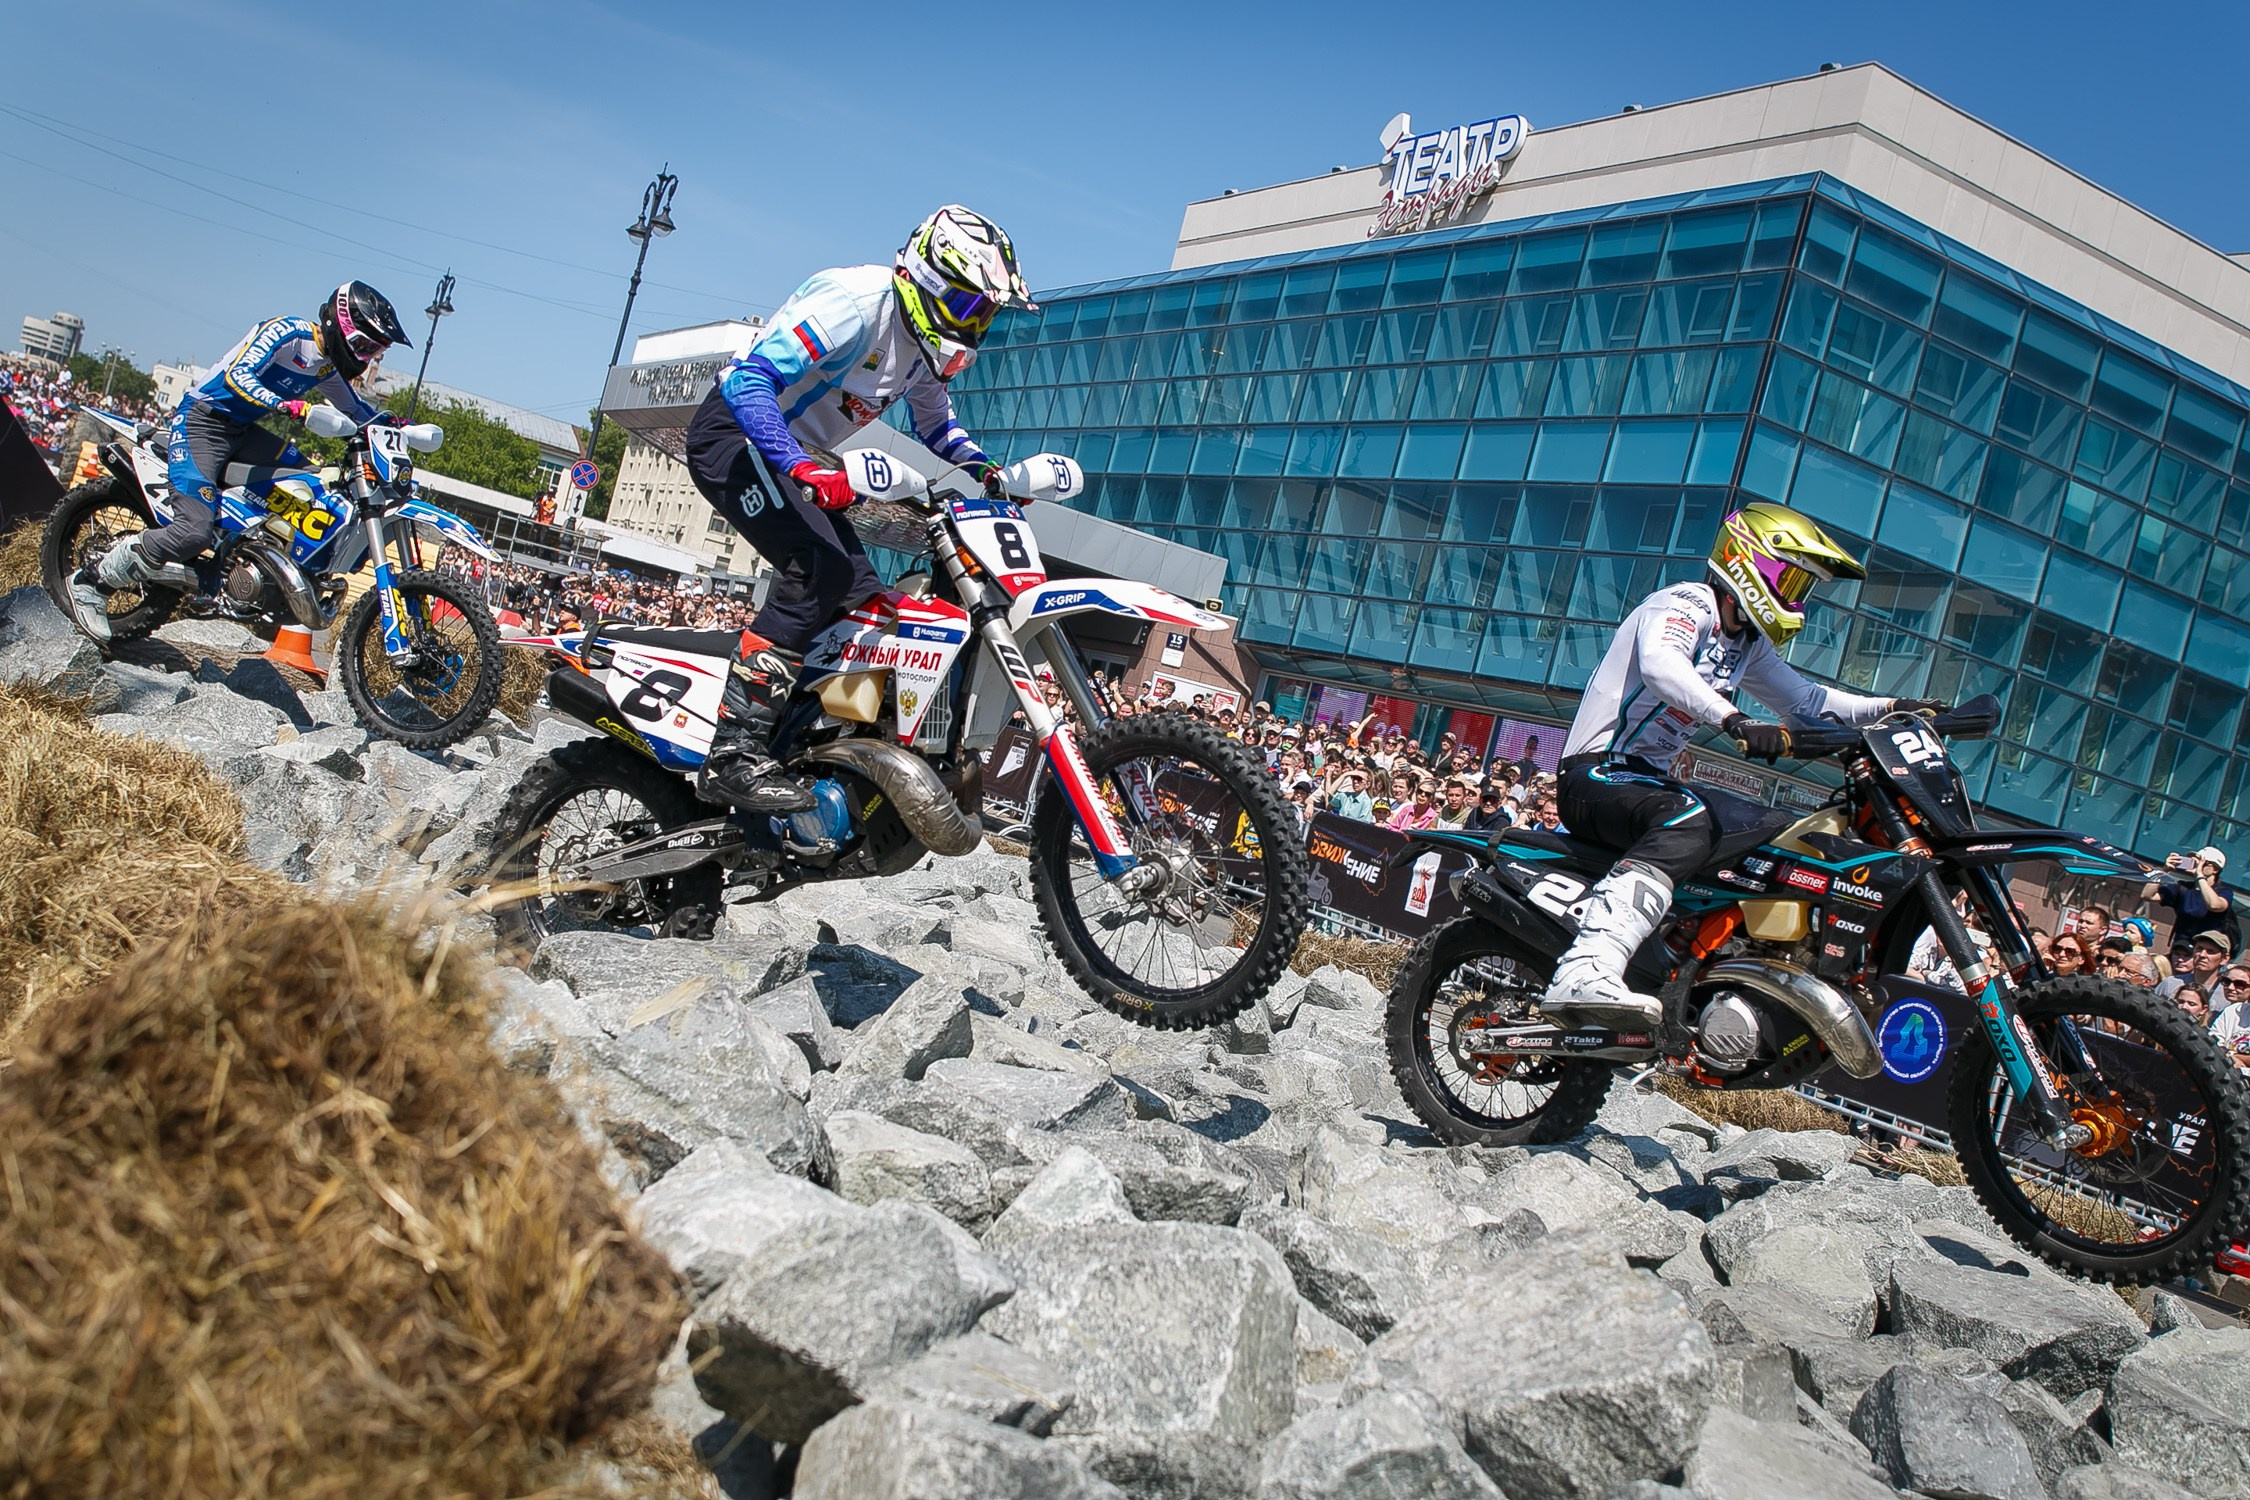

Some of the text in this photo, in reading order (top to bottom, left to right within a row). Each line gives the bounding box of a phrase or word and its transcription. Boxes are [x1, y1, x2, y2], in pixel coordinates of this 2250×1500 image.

[1389, 114, 1521, 197] ТЕАТР
[338, 290, 355, 333] 100%
[254, 320, 295, 351] TEAM
[383, 429, 402, 452] 27
[242, 488, 269, 510] TEAM
[266, 485, 337, 541] DRC
[993, 521, 1031, 570] 8
[379, 588, 392, 619] TEAM
[1044, 592, 1087, 609] X-GRIP
[1726, 555, 1777, 625] invoke
[391, 587, 408, 637] DRC
[1170, 634, 1184, 645] 15
[841, 643, 943, 672] ЮЖНЫЙ УРАЛ
[620, 669, 693, 723] 8
[595, 716, 660, 760] ACERB
[1891, 729, 1944, 765] 24
[1832, 876, 1883, 902] invoke
[1113, 992, 1155, 1012] X-GRIP
[2178, 1111, 2207, 1127] УРАЛ
